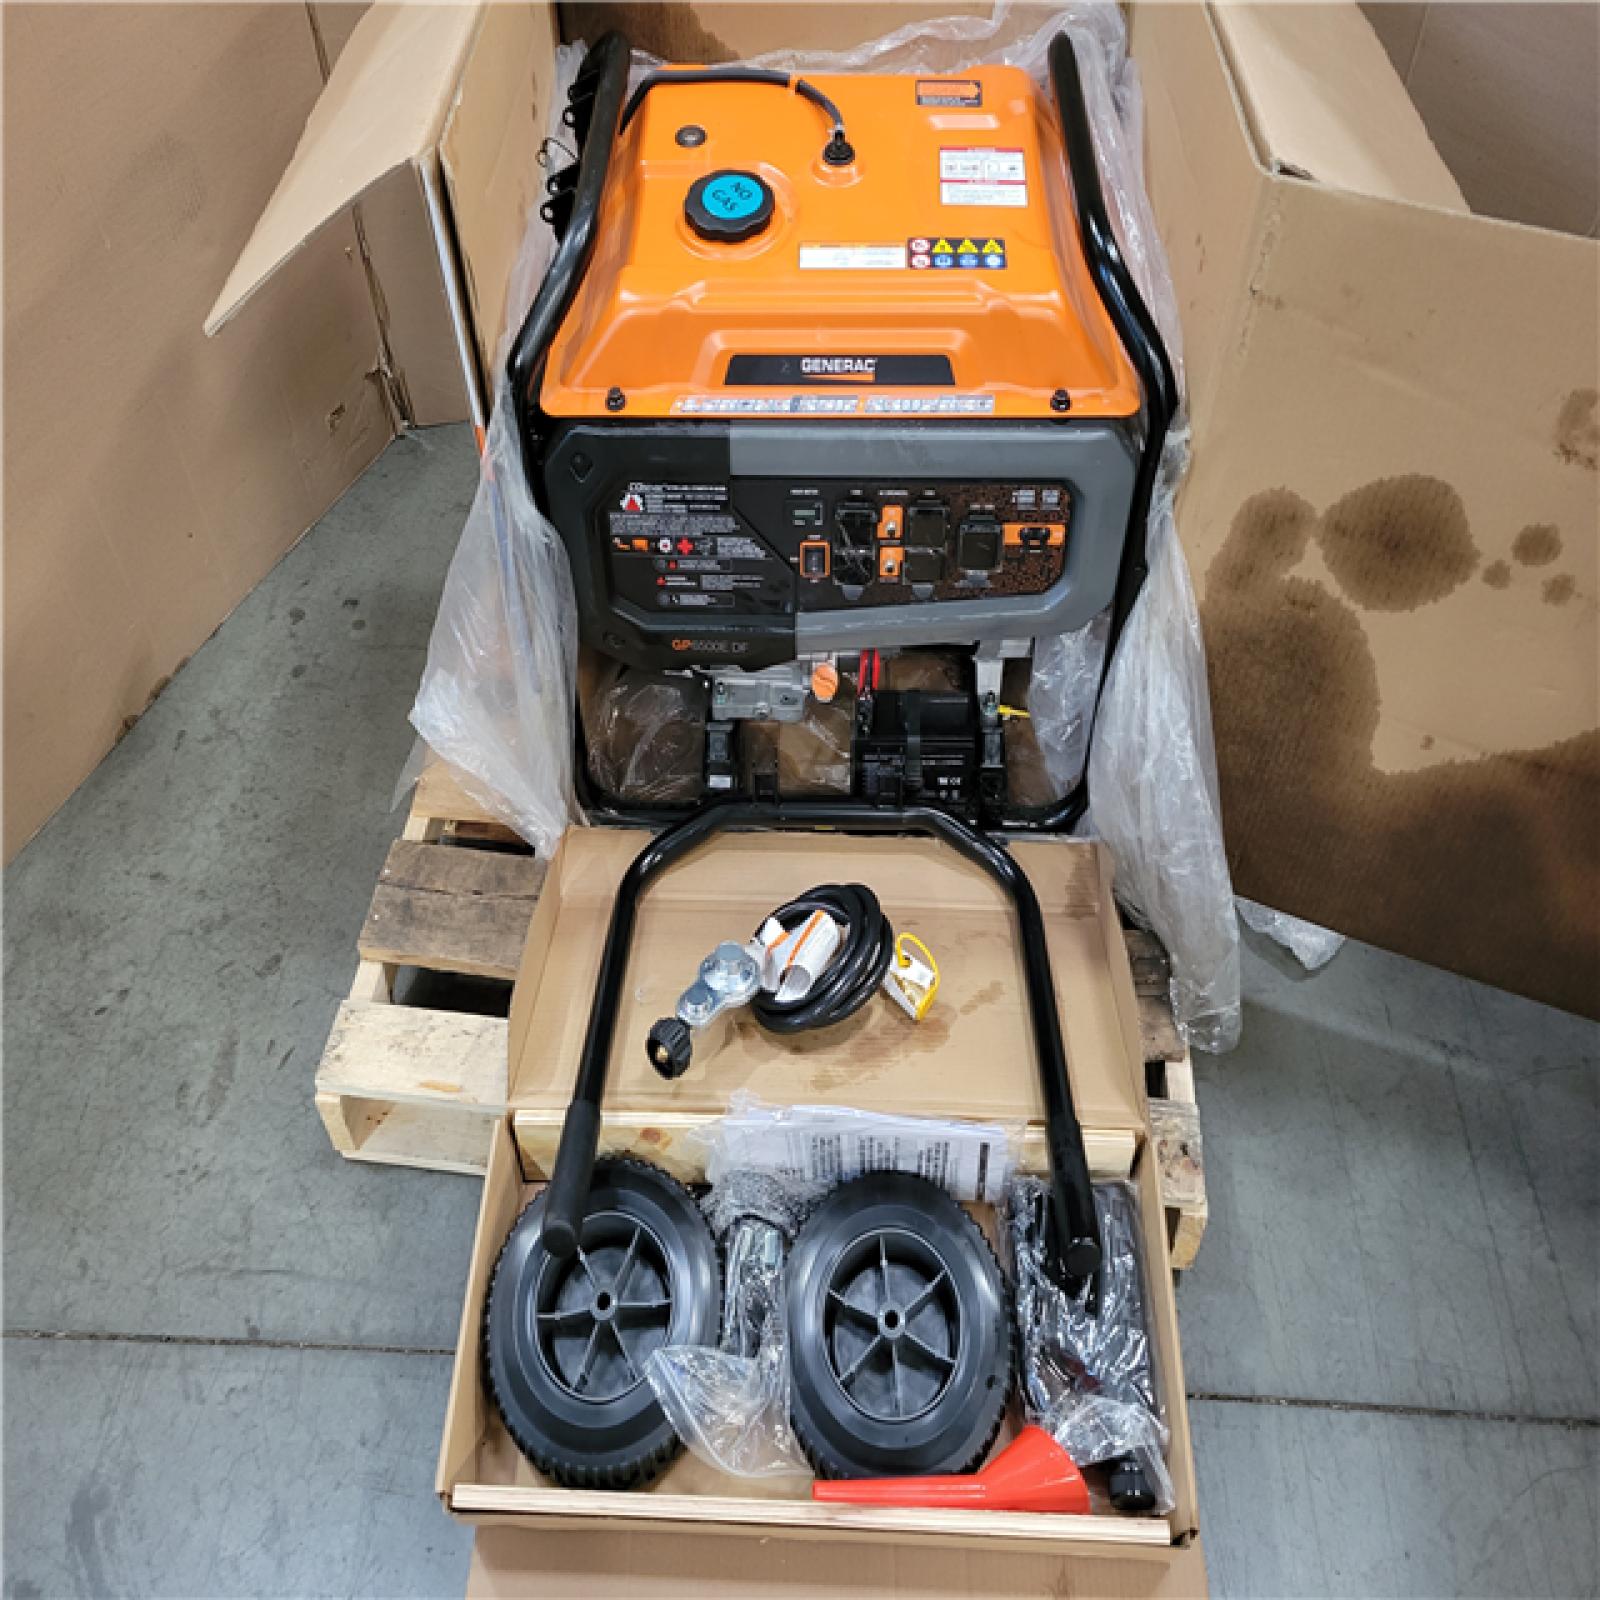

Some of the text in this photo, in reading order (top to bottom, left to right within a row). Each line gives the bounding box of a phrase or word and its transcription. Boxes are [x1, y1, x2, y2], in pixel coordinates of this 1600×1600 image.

[711, 189, 739, 212] GAS
[729, 181, 752, 201] NO
[801, 357, 876, 372] GENERAC
